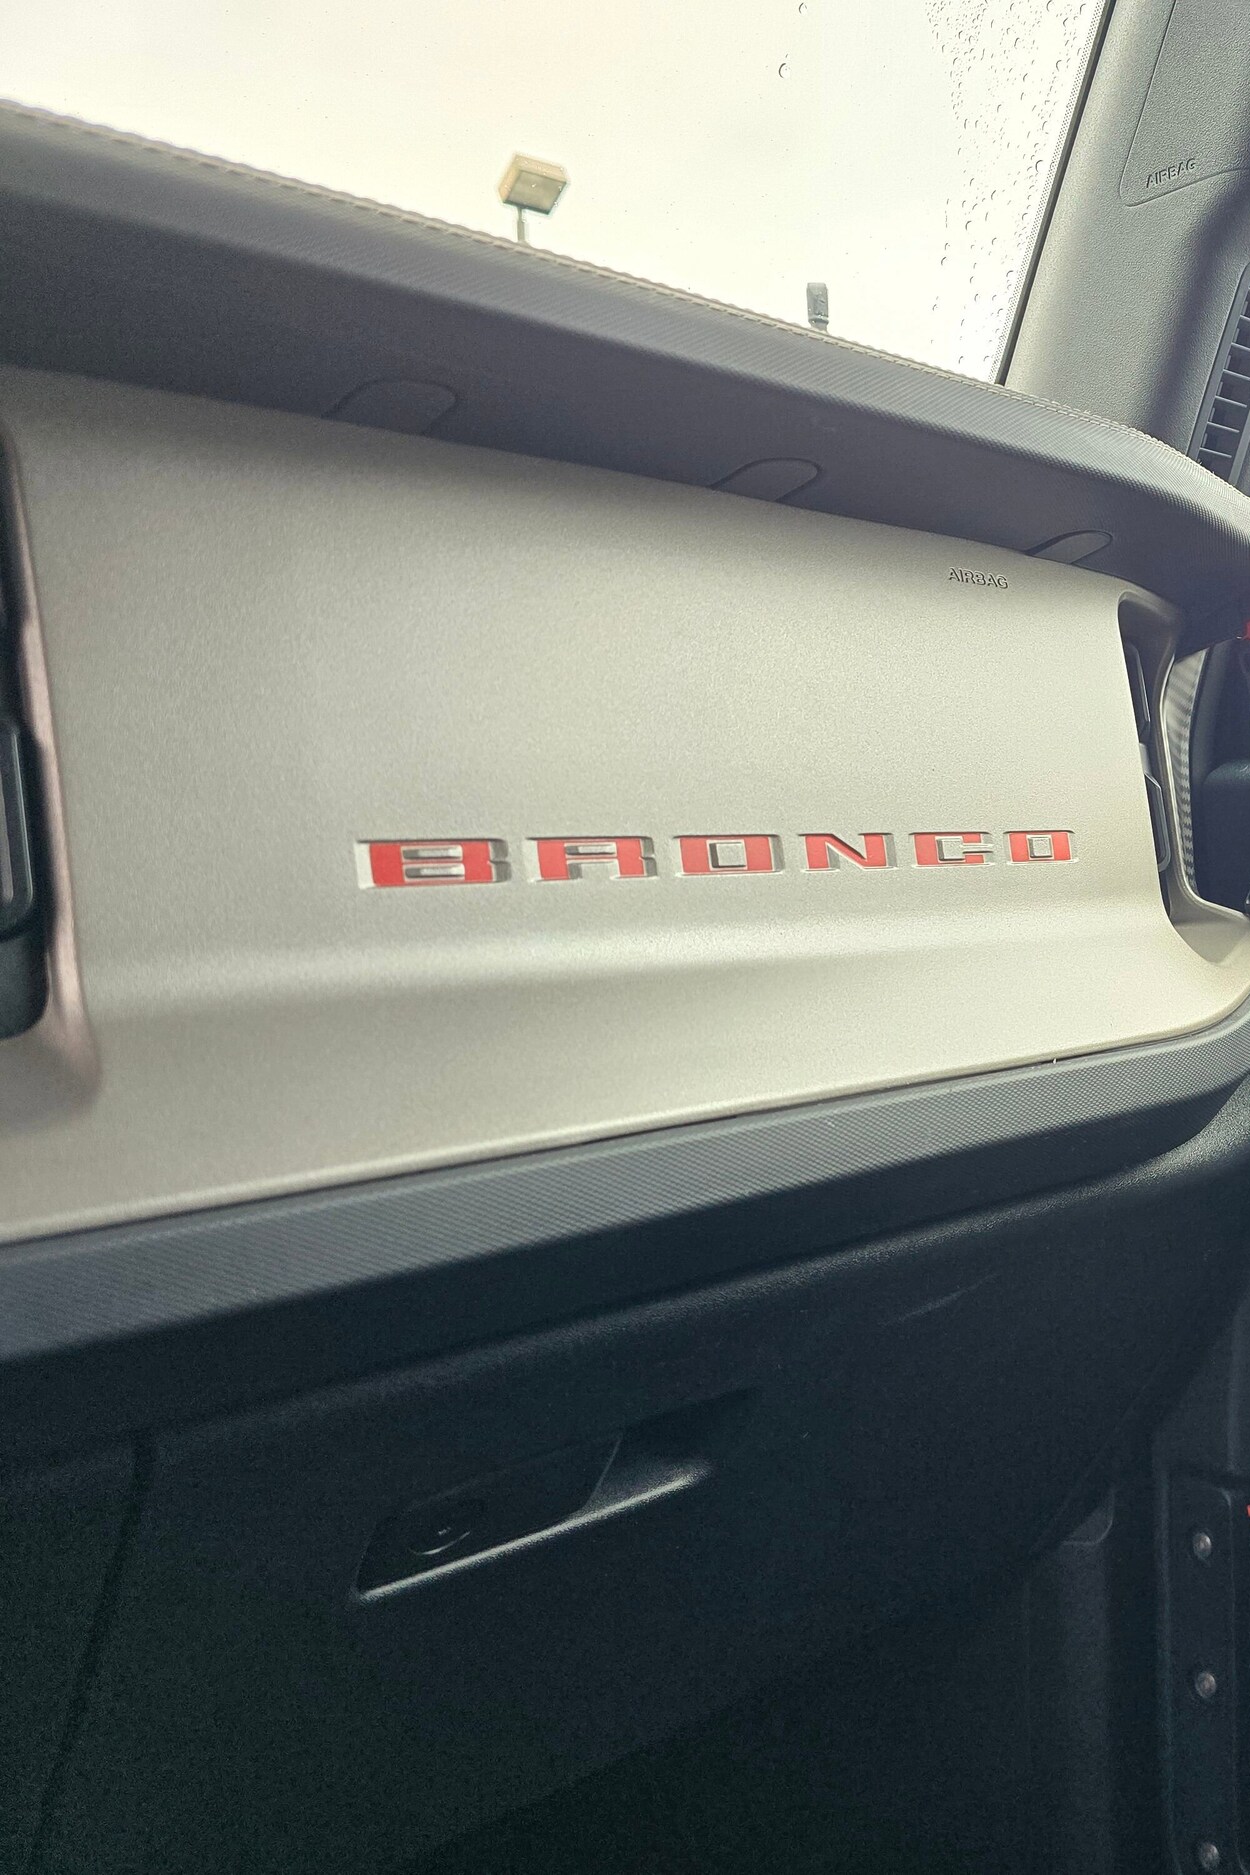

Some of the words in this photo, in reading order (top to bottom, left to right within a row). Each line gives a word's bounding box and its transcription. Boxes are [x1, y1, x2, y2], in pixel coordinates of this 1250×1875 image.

[1145, 157, 1197, 189] AIRBAG
[948, 566, 1009, 589] AIRBAG
[354, 830, 1078, 889] BRONCO
